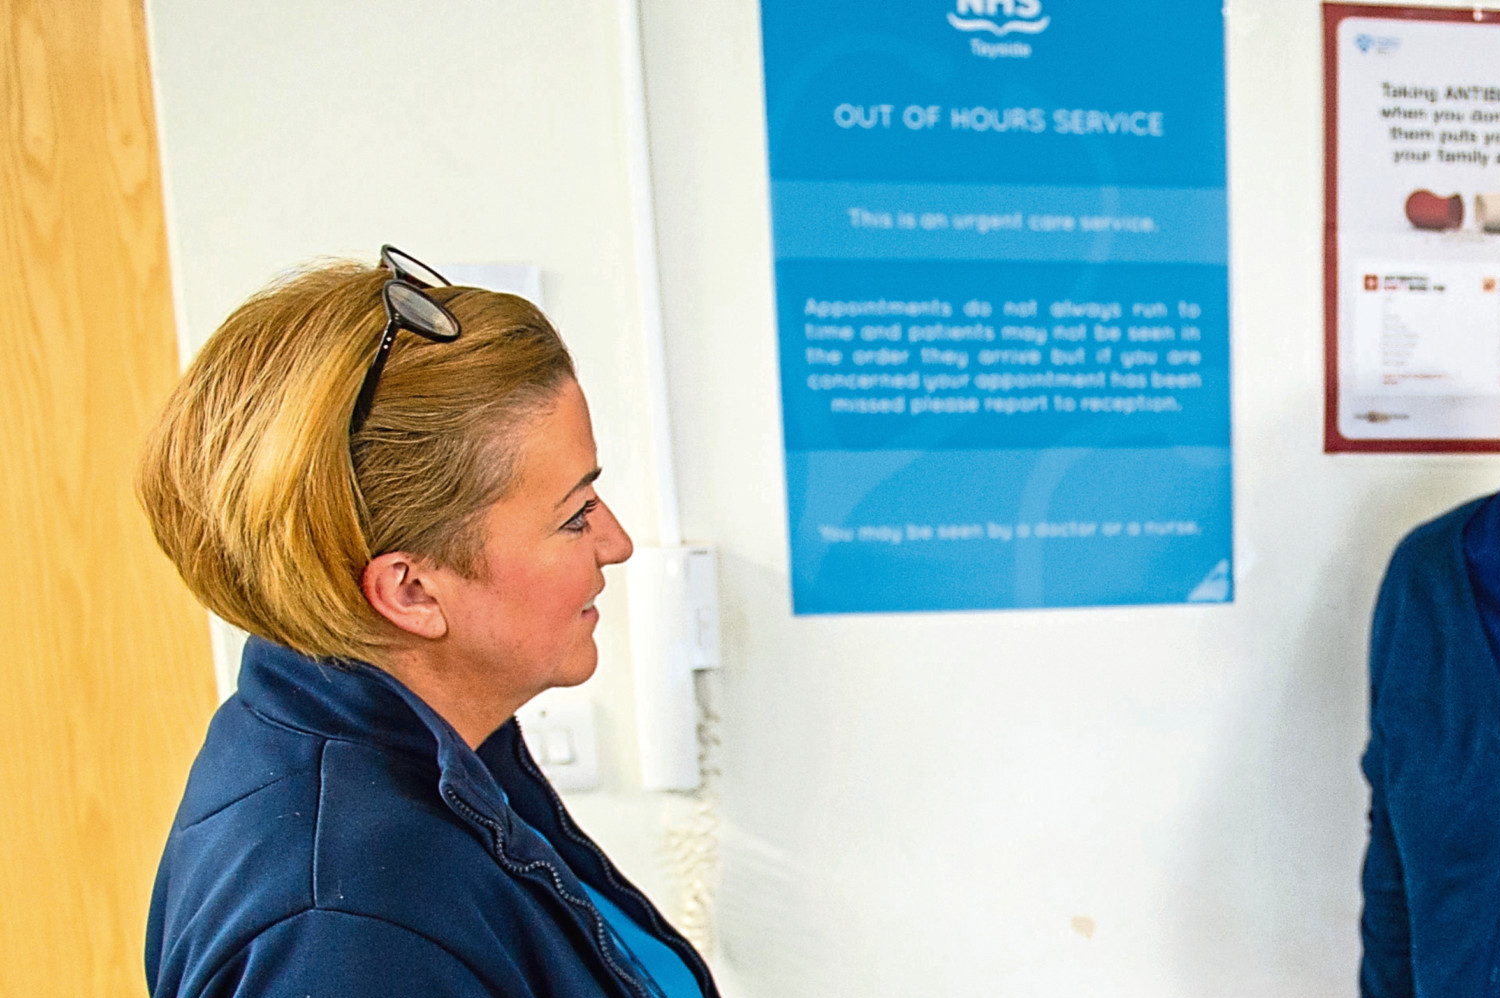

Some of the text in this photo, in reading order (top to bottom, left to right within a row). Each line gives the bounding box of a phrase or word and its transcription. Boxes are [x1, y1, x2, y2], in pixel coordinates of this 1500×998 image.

[1381, 83, 1438, 103] Taking
[833, 104, 1164, 136] OUT OF HOURS SERVICE
[1380, 106, 1426, 119] when
[1433, 110, 1464, 125] you
[1390, 126, 1432, 141] them
[1439, 129, 1477, 145] puts
[1394, 150, 1431, 164] your
[1437, 149, 1489, 166] family
[849, 209, 893, 228] This
[897, 211, 917, 229] is
[920, 213, 948, 230] an
[952, 212, 1023, 233] urgent
[1028, 215, 1076, 231] care
[805, 299, 1201, 321] Appointments do not always run to
[805, 324, 1201, 346] time and patients may not be seen in
[806, 347, 1201, 369] the order they arrive but if you are
[807, 372, 1202, 393] concerned your appointment has been
[831, 397, 905, 413] missed
[910, 397, 979, 414] please
[984, 397, 1048, 414] report
[1054, 395, 1075, 411] to
[819, 524, 853, 541] You
[859, 526, 903, 544] may
[906, 524, 933, 540] be
[937, 524, 983, 539] seen
[987, 522, 1013, 542] by
[1033, 520, 1097, 538] doctor
[1102, 522, 1122, 537] or
